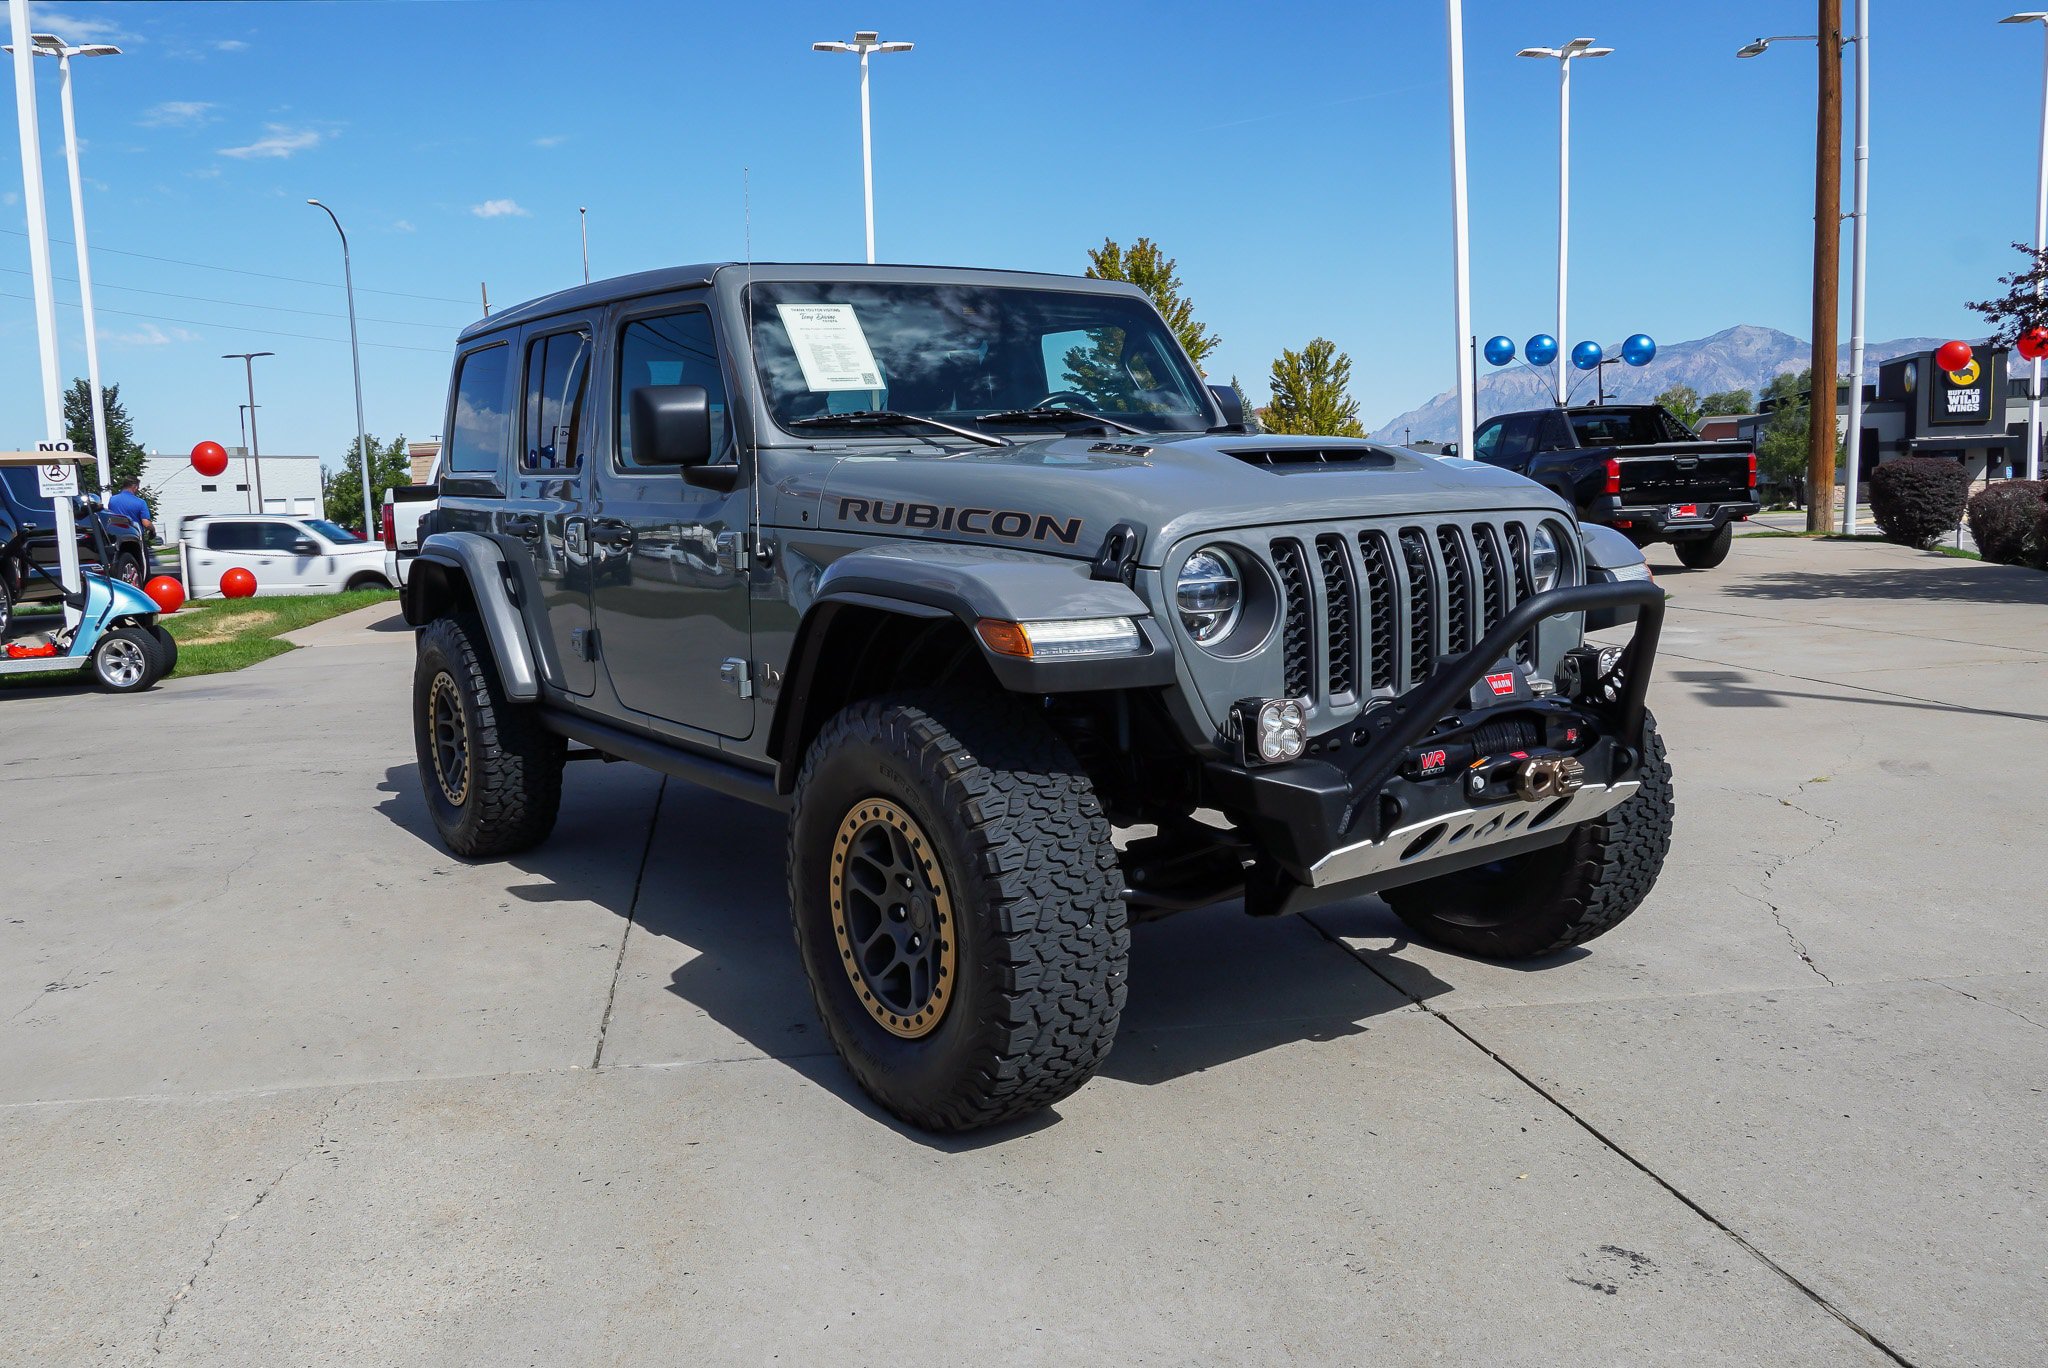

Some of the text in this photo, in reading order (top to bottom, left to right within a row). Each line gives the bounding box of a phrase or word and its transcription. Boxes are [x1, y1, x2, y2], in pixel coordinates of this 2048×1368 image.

[1947, 395, 1980, 405] WILD
[1947, 404, 1980, 413] WINGS
[39, 442, 69, 452] NO
[837, 497, 1084, 545] RUBICON
[1492, 679, 1512, 689] WARN
[1421, 750, 1446, 769] VR
